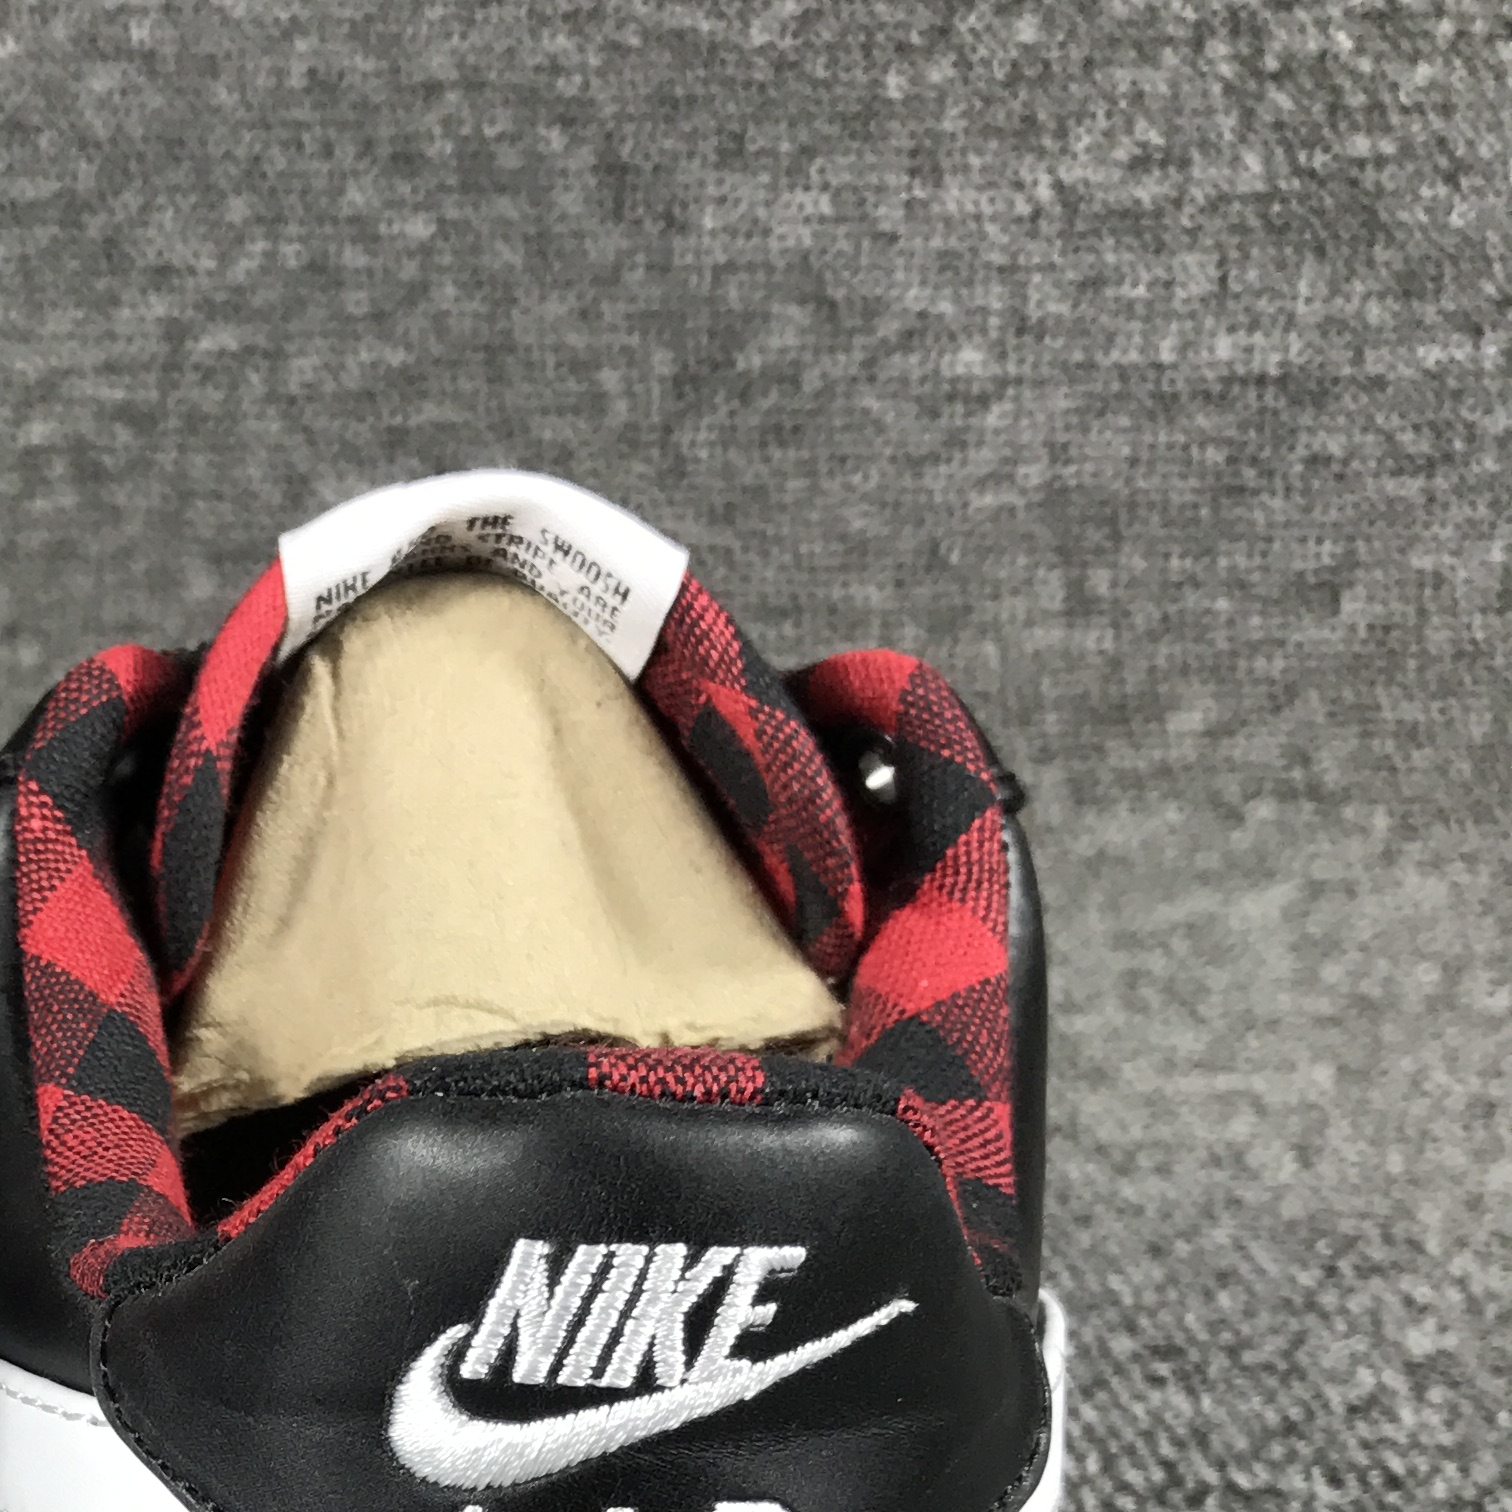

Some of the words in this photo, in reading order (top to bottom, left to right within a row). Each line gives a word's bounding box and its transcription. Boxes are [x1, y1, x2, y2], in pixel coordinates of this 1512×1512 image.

[315, 571, 371, 612] NIKE
[465, 513, 513, 531] THE
[541, 527, 631, 605] SWOOSH
[460, 1238, 807, 1390] NIKE
